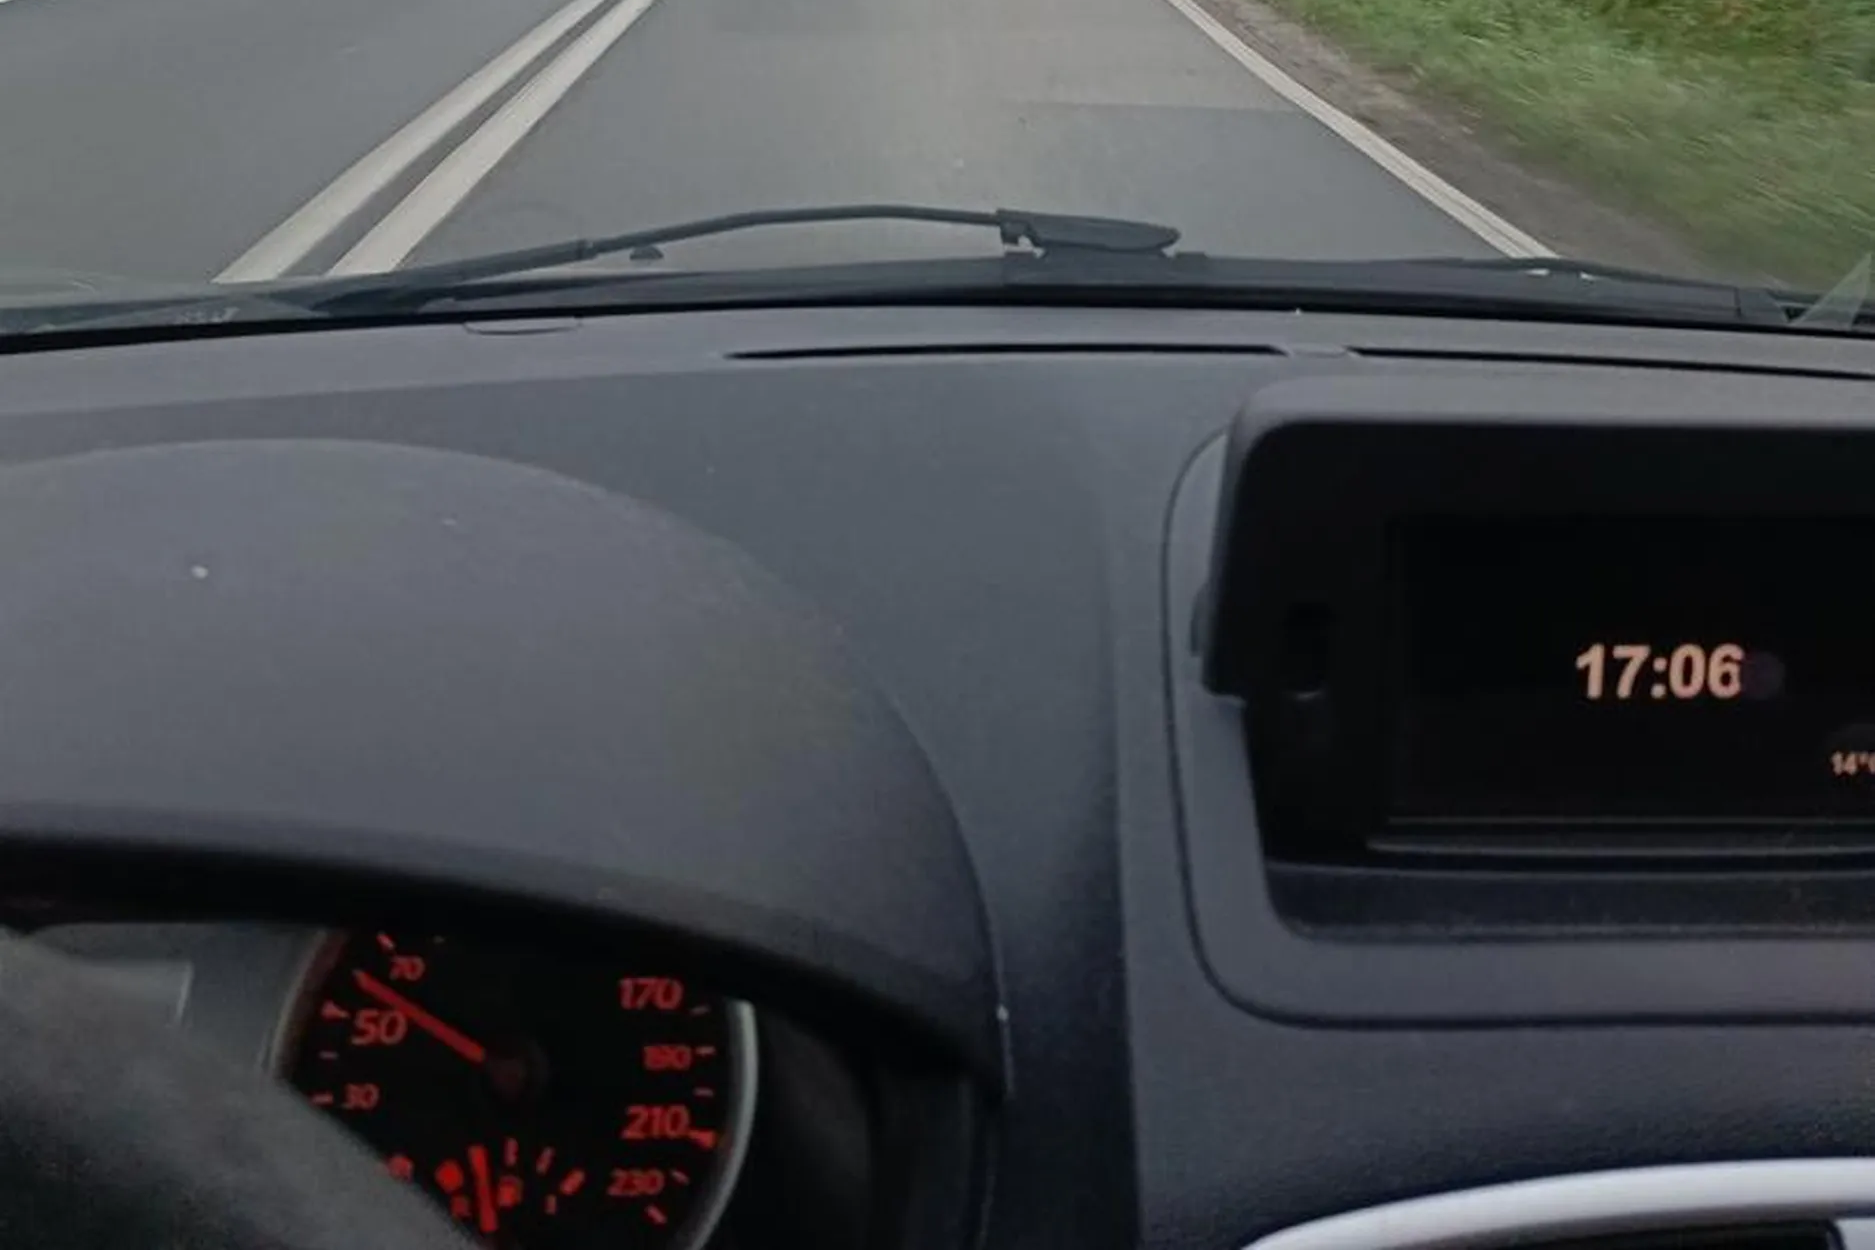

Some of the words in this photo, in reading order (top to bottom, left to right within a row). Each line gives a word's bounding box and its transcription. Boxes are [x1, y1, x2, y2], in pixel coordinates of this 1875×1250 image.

[1575, 643, 1745, 699] 17:06
[389, 955, 426, 982] 70
[619, 978, 684, 1010] 170
[351, 1009, 407, 1045] 50
[621, 1104, 690, 1139] 210
[607, 1169, 665, 1196] 230
